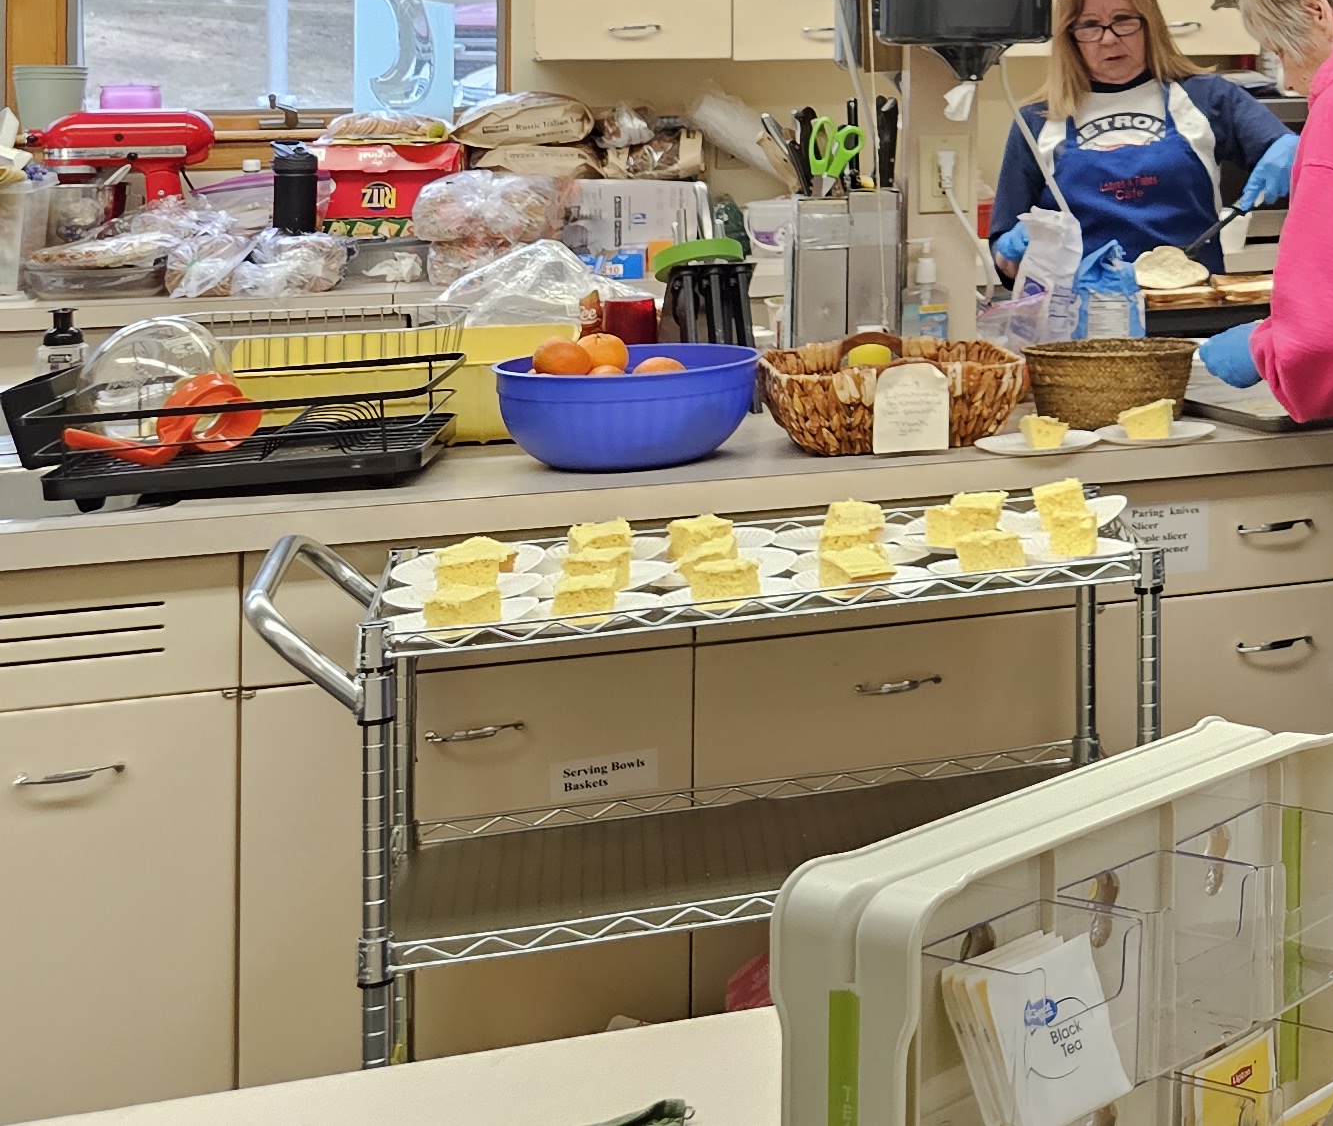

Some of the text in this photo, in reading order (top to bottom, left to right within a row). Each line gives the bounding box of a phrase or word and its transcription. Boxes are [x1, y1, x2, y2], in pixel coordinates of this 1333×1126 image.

[515, 123, 540, 131] Rustic
[543, 116, 570, 128] Italian
[361, 187, 397, 209] RITZ
[1131, 506, 1200, 518] Paring knives
[1131, 521, 1159, 530] Slicer
[1161, 532, 1188, 541] slicer
[562, 758, 646, 779] Serving Bowls
[563, 778, 609, 793] Baskets
[1049, 1018, 1084, 1046] Black
[1060, 1038, 1083, 1058] Tea
